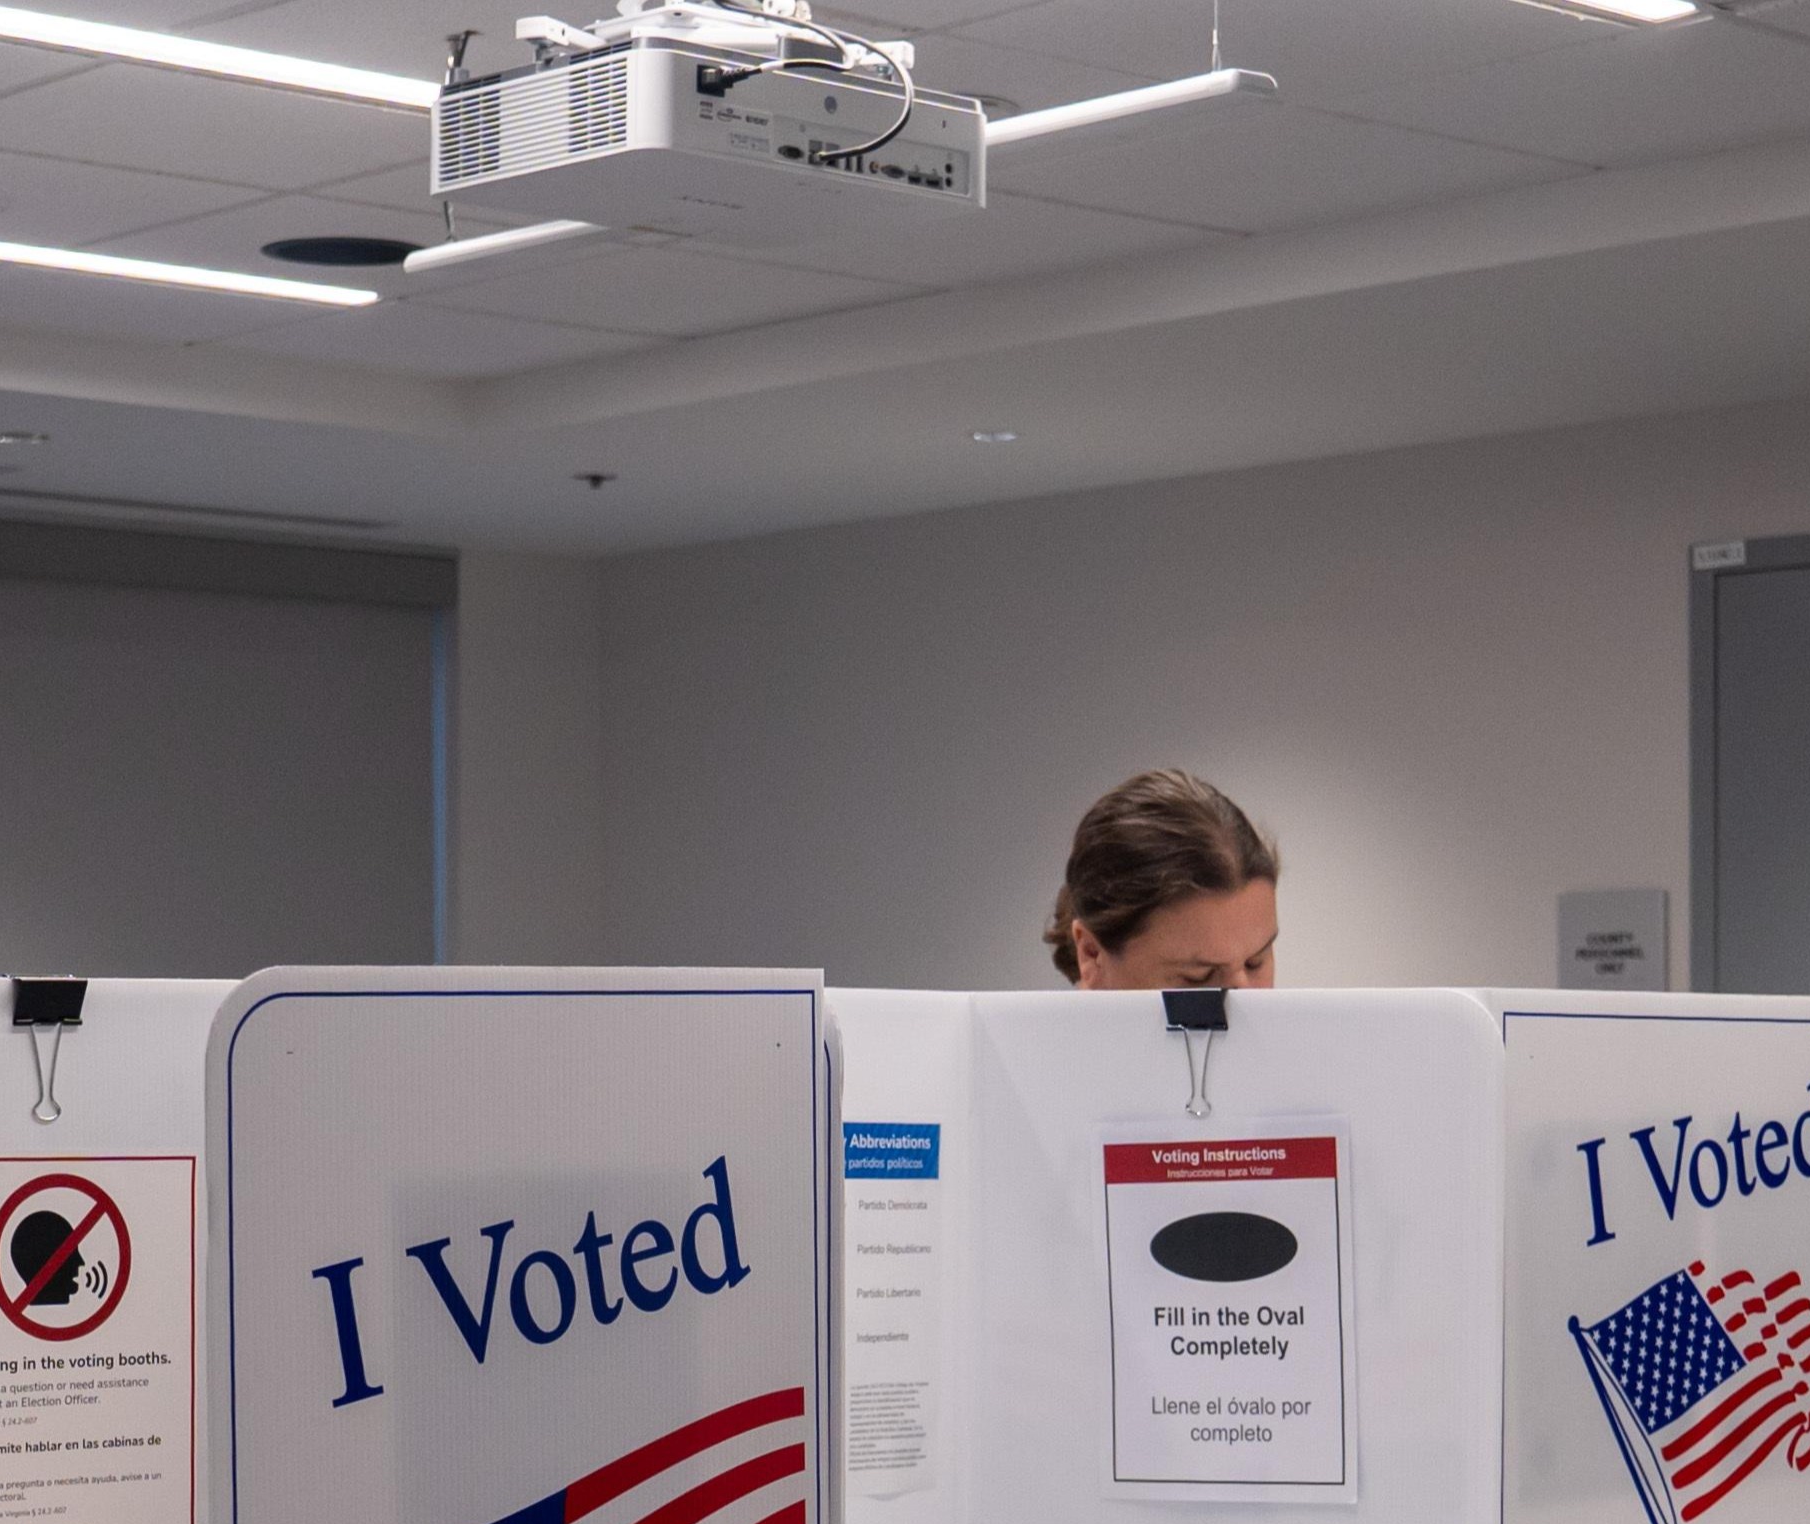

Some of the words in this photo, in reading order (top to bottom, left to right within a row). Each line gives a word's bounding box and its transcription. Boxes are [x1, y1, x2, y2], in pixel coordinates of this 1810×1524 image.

[850, 1133, 931, 1149] Abbreviations
[849, 1158, 884, 1170] partidos
[1152, 1150, 1200, 1166] Voting
[1204, 1147, 1286, 1163] Instructions
[1167, 1168, 1226, 1179] Instrucciones
[1229, 1168, 1247, 1178] para
[1249, 1166, 1273, 1176] Votar
[1576, 1137, 1617, 1247] I
[312, 1257, 385, 1408] I
[406, 1155, 750, 1364] Voted
[1154, 1307, 1185, 1326] Fill
[1192, 1307, 1210, 1326] in
[1218, 1307, 1249, 1326] the
[1257, 1306, 1304, 1326] Oval
[1171, 1336, 1288, 1360] Completely
[23, 1357, 36, 1370] in
[41, 1356, 64, 1369] the
[69, 1354, 114, 1369] voting
[119, 1352, 171, 1366] booths.
[9, 1381, 54, 1394] question
[57, 1382, 66, 1391] or
[69, 1379, 95, 1390] need
[97, 1378, 149, 1389] assistance
[6, 1399, 18, 1408] an
[21, 1396, 61, 1408] Election
[65, 1394, 100, 1405] Officer.
[1152, 1397, 1200, 1414] Llene
[1207, 1397, 1221, 1414] el
[1228, 1397, 1275, 1414] óvalo
[1282, 1400, 1311, 1419] por
[25, 1441, 62, 1453] hablar
[66, 1441, 79, 1450] en
[83, 1439, 99, 1449] las
[102, 1437, 144, 1448] cabinas
[147, 1435, 161, 1446] de
[1190, 1424, 1272, 1445] completo
[6, 1479, 44, 1491] pregunta
[54, 1476, 89, 1486] necesita
[91, 1474, 118, 1485] ayuda,
[121, 1472, 142, 1482] avise
[152, 1472, 161, 1480] un
